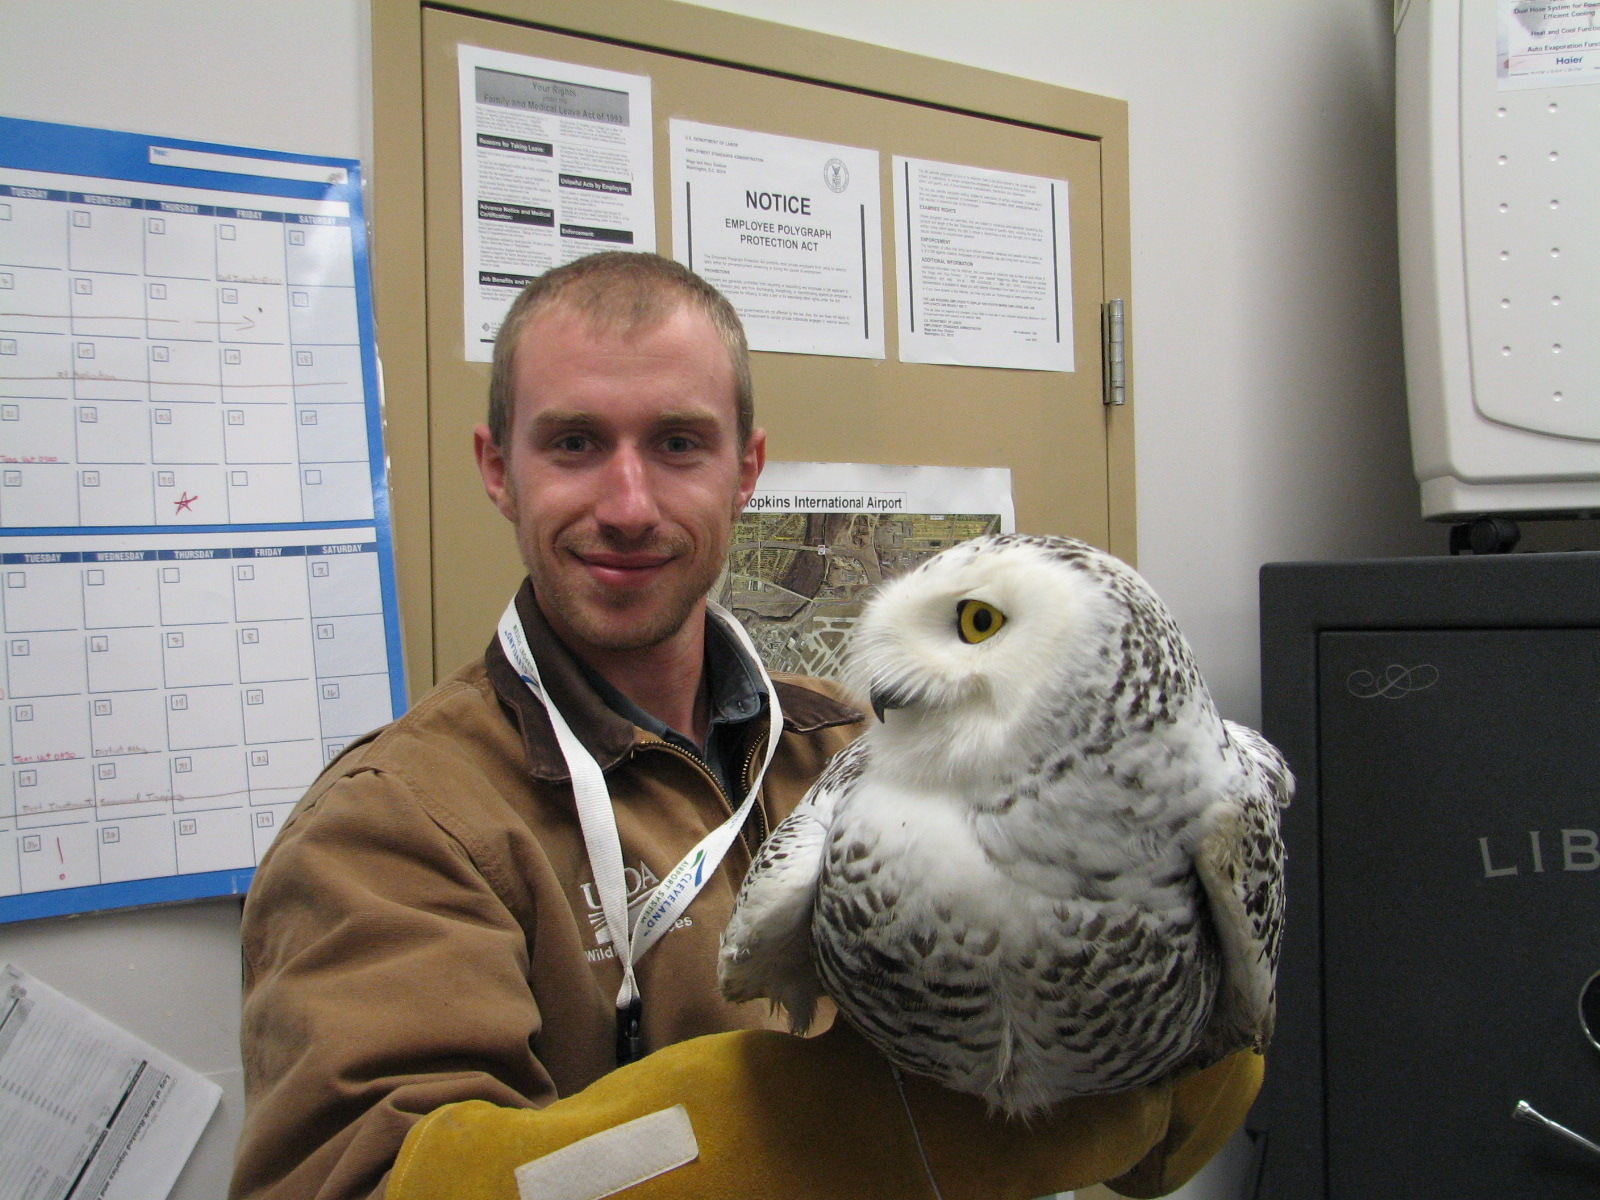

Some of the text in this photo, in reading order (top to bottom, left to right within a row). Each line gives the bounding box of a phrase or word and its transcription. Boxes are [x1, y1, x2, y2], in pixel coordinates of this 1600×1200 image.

[1548, 4, 1570, 12] System
[1545, 43, 1582, 51] Evaporation
[532, 82, 576, 97] Your Rights
[484, 94, 509, 106] Family
[511, 100, 526, 108] and
[528, 102, 557, 113] Medical
[559, 106, 581, 115] Leave
[582, 110, 595, 118] Act
[479, 137, 502, 147] Reasons
[510, 142, 528, 152] Taking
[560, 178, 582, 188] Unlawful
[10, 187, 48, 199] TUESDAY
[83, 195, 132, 207] WEDNESDAY
[746, 190, 811, 215] NOTICE
[161, 203, 199, 213] THURSDAY
[236, 210, 263, 219] FRIDAY
[299, 216, 337, 225] SATURDAY
[725, 219, 832, 239] EMPLOYEE POLYGRAPH
[741, 235, 818, 251] PROTECTION ACT
[492, 277, 514, 285] Benefits
[794, 496, 864, 508] International
[867, 496, 902, 510] Airport
[174, 549, 214, 560] THURSDAY
[255, 548, 282, 557] FRIDAY
[322, 545, 362, 553] SATURDAY
[25, 554, 61, 562] TUESDAY
[97, 552, 144, 561] WEDNESDAY
[1479, 829, 1600, 878] LIB
[580, 861, 659, 910] UDA
[641, 861, 689, 923] AIRPORT SYSTEM
[647, 873, 692, 927] CLEVELAND
